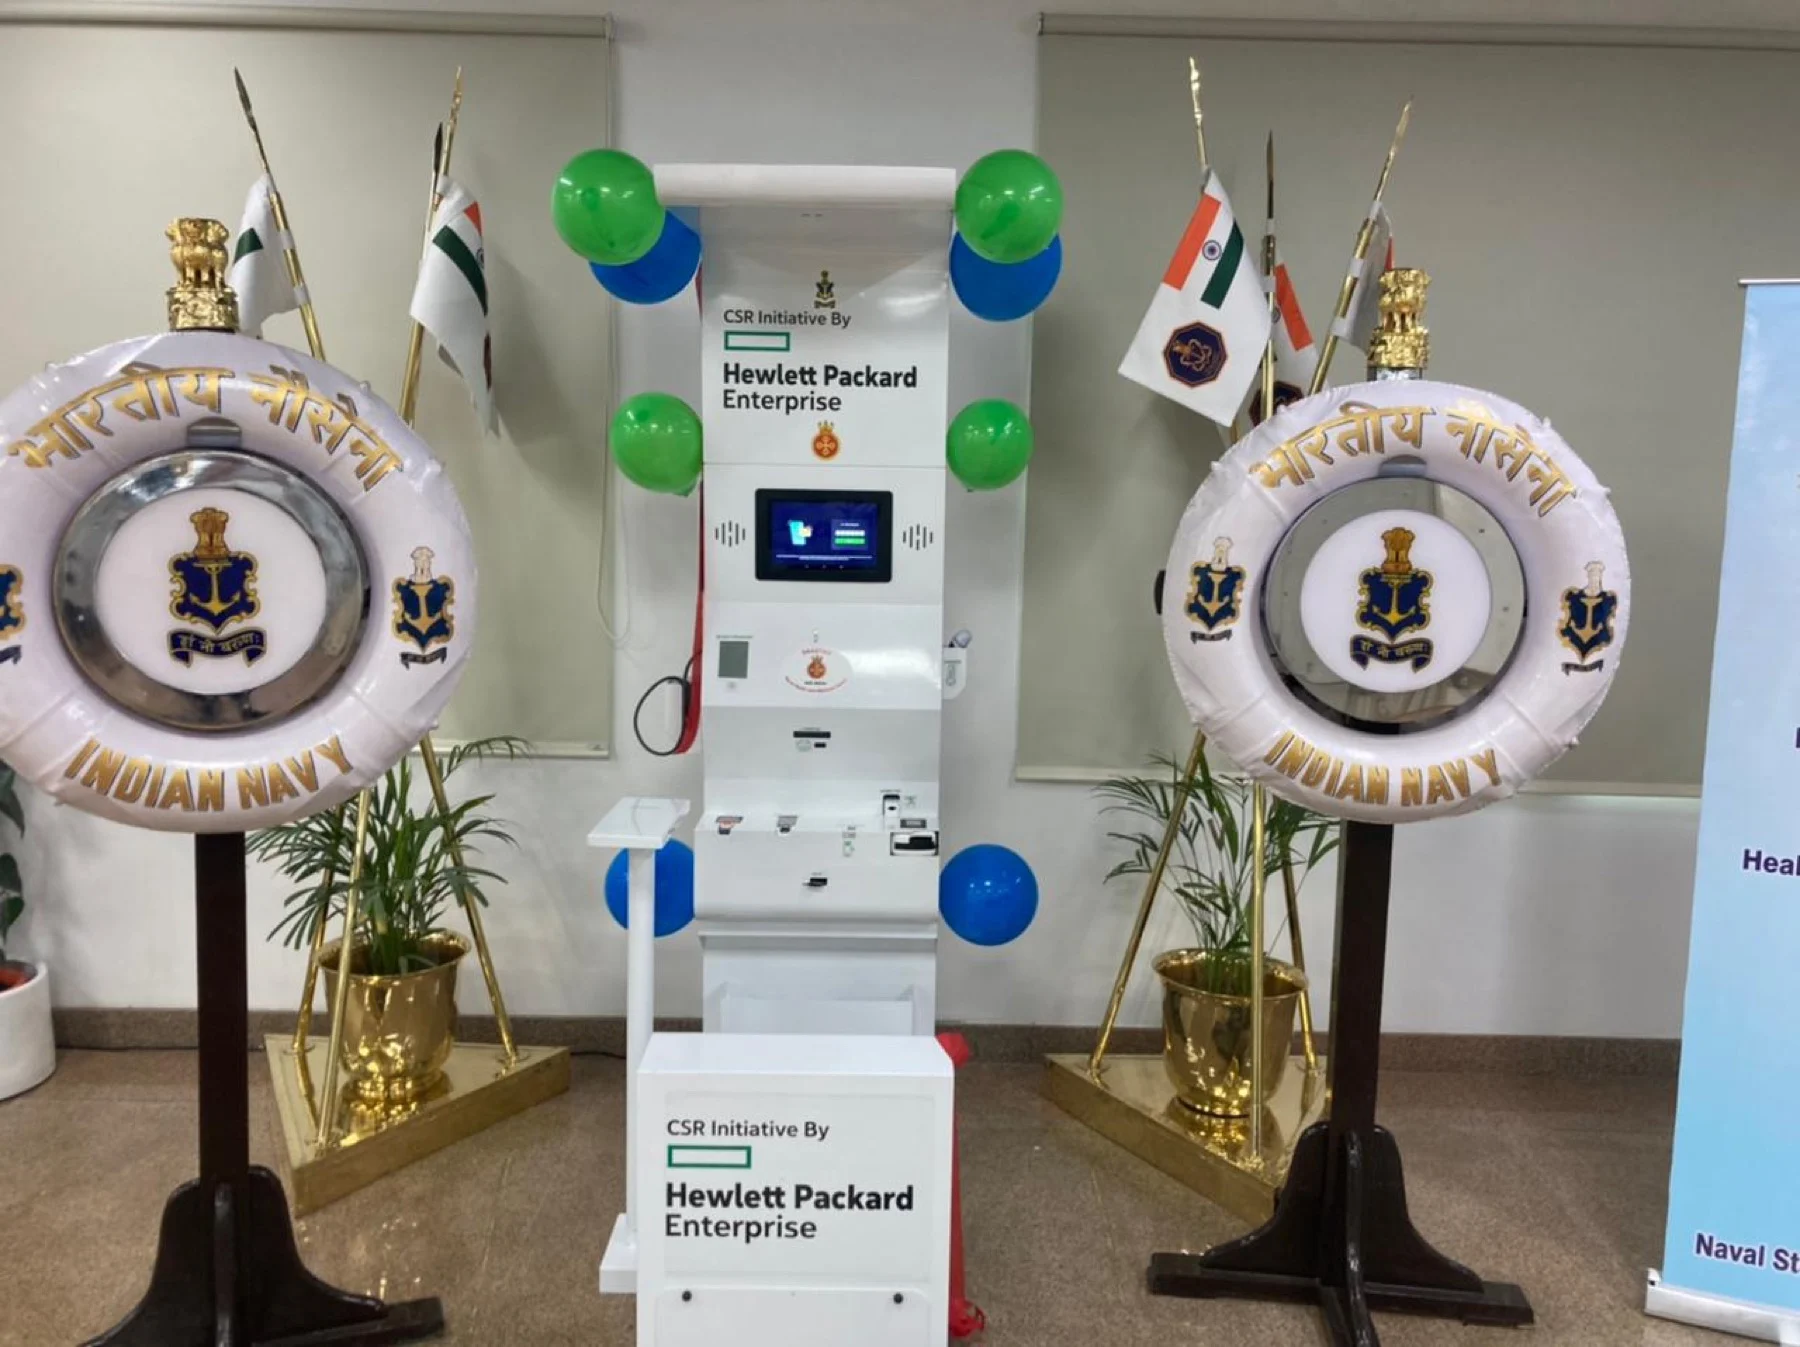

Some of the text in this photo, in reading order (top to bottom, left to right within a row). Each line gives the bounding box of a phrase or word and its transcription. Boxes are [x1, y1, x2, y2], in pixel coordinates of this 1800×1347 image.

[723, 309, 852, 328] CSR Initiative By
[723, 362, 917, 388] Hewlett Packard
[723, 389, 842, 415] Enterprise
[7, 361, 404, 492] भारतीय नौसेना
[1249, 400, 1437, 489] भारतीय
[63, 735, 354, 812] INDIAN NAVY
[1263, 729, 1502, 807] INDIAN NAVY
[667, 1119, 830, 1141] CSR Initiative By
[666, 1182, 914, 1211] Hewlett Packard
[665, 1213, 818, 1244] Enterprise
[1696, 1232, 1766, 1268] Naval
